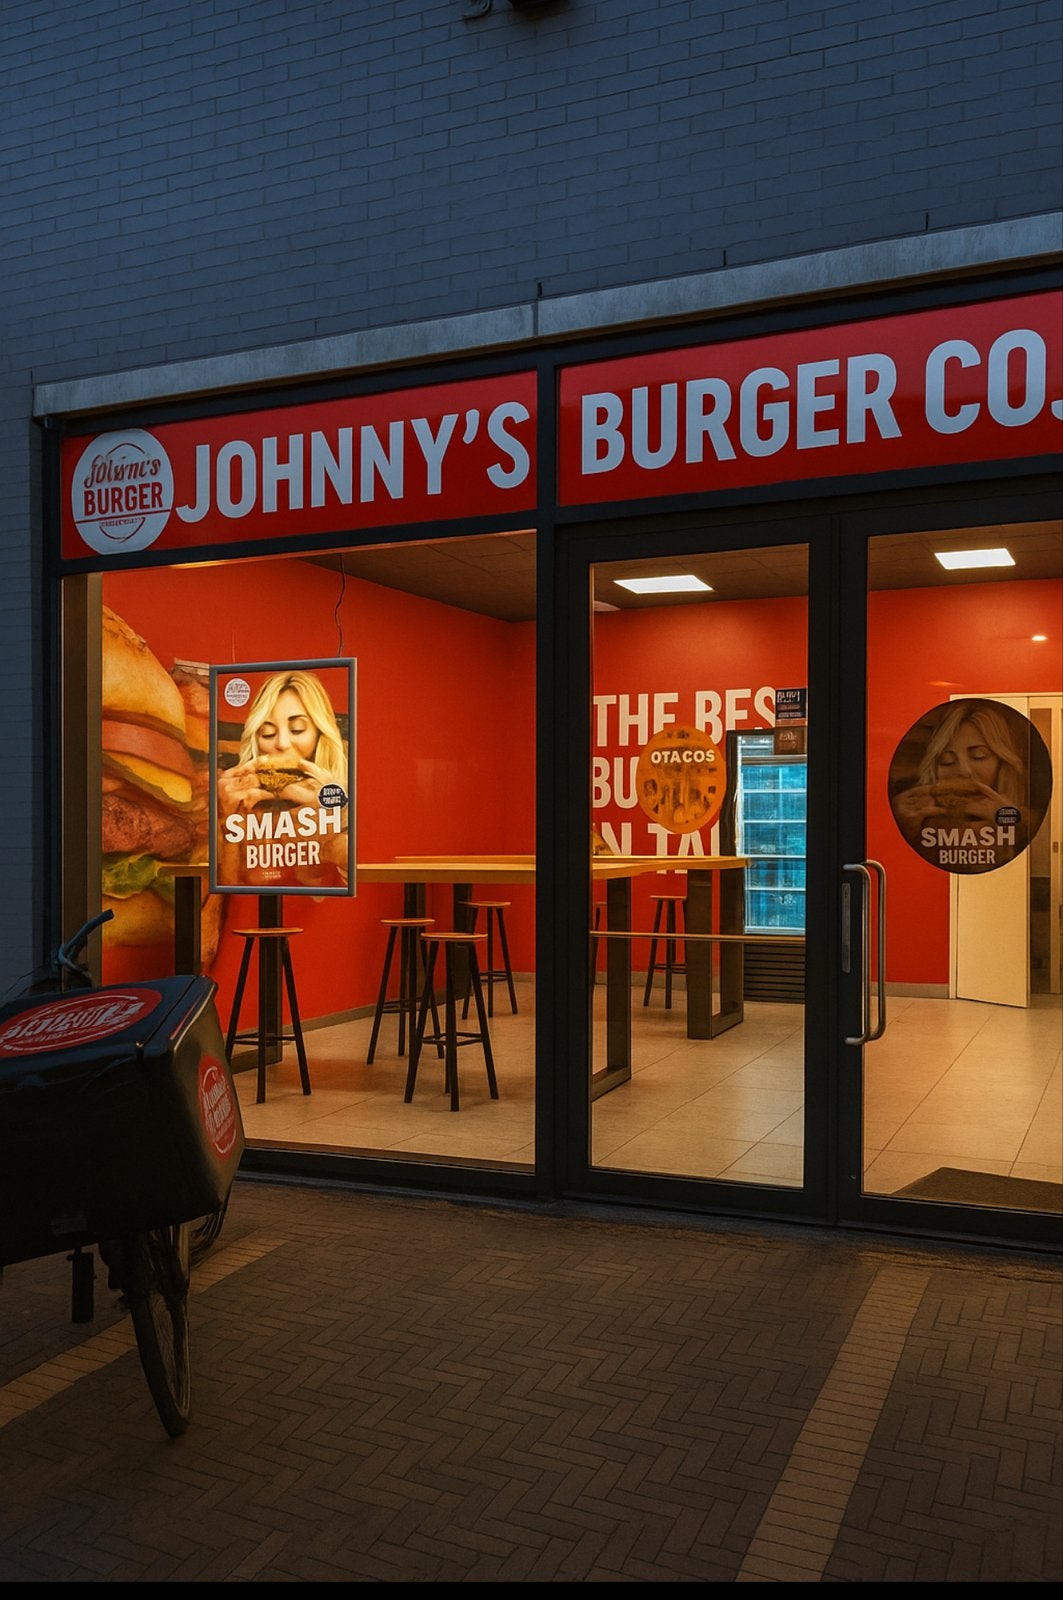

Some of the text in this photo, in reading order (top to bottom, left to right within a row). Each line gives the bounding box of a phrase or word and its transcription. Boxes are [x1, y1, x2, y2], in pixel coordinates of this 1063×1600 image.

[175, 401, 530, 523] JOHNNY’S
[581, 353, 902, 475] BURGER
[84, 481, 163, 517] BURGER
[593, 691, 679, 747] THE
[651, 749, 716, 764] OTACOS
[225, 806, 341, 843] SMASH
[920, 825, 1016, 848] SMASH
[246, 840, 320, 869] BURGER
[939, 850, 996, 865] BURGER
